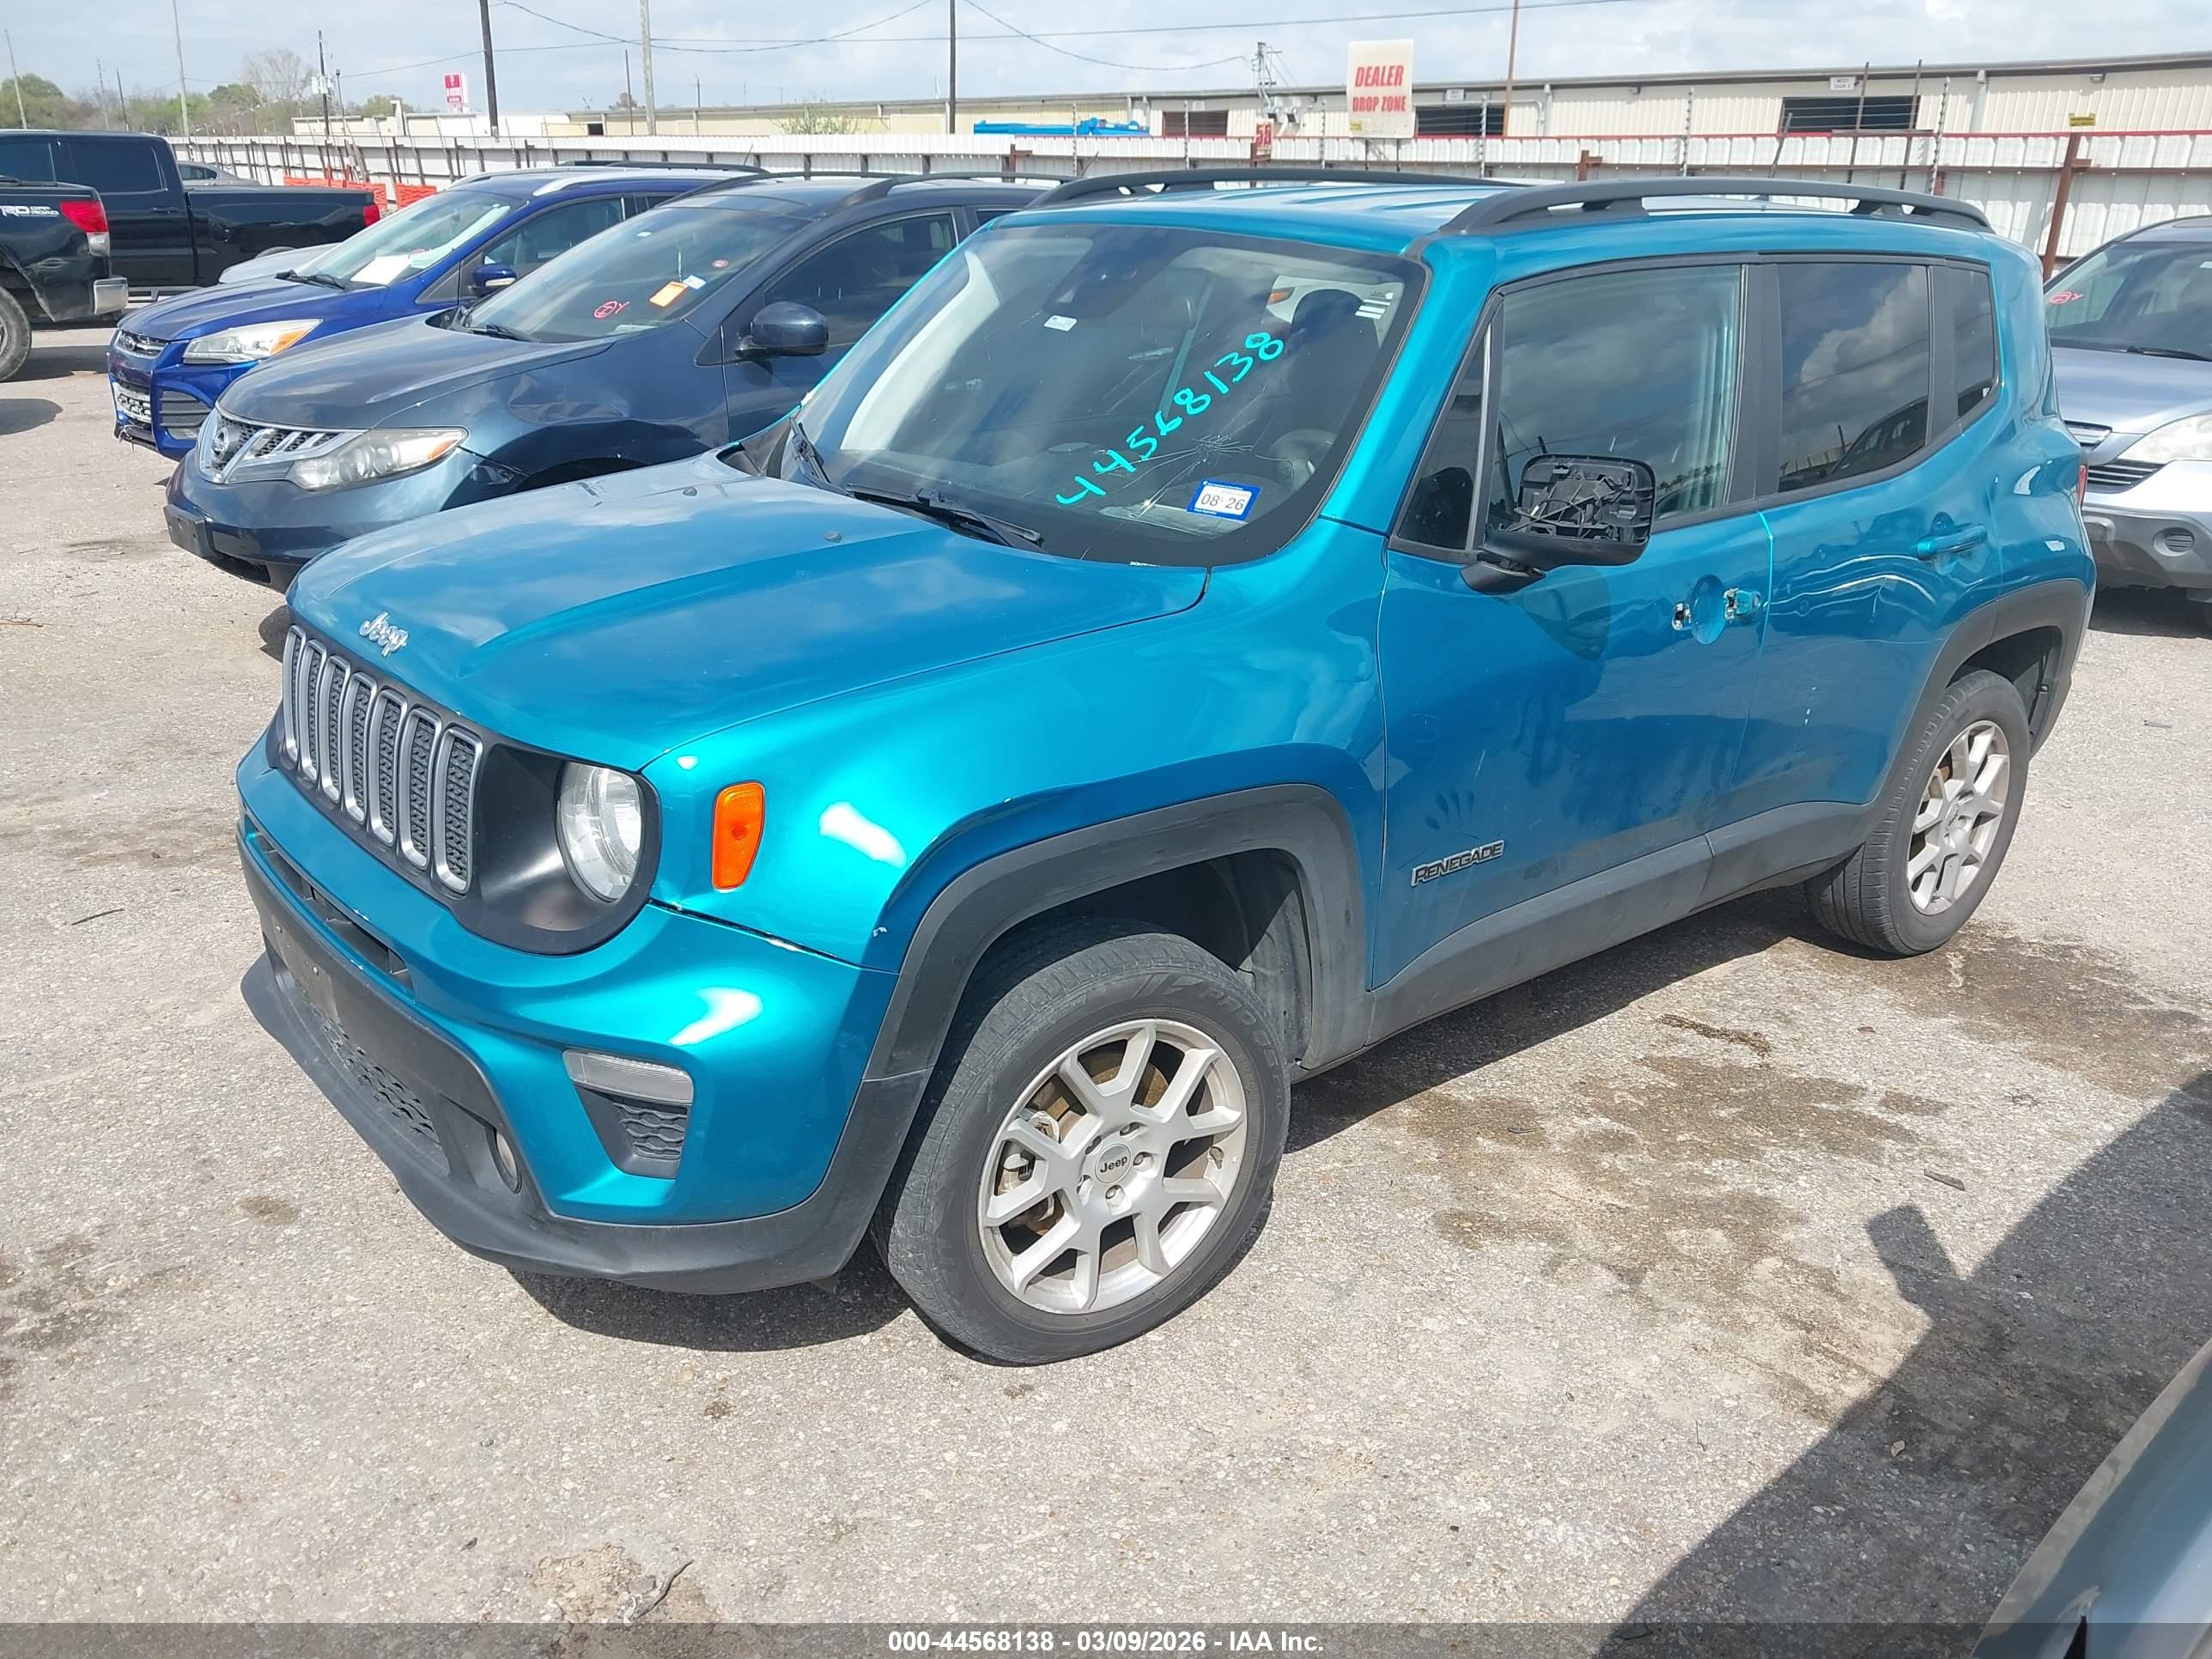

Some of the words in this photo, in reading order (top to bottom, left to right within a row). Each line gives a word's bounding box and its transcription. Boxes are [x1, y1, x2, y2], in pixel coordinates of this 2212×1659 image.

[1354, 64, 1405, 88] DEALER
[1352, 96, 1379, 112] DROP
[1380, 95, 1407, 112] ZONE
[0, 205, 30, 217] RD
[1055, 331, 1285, 505] 44568138
[1200, 493, 1220, 507] 08
[1224, 496, 1246, 511] 26
[359, 611, 409, 658] Jeep
[1411, 839, 1505, 887] RENEGADE
[1099, 1155, 1128, 1174] Jeep
